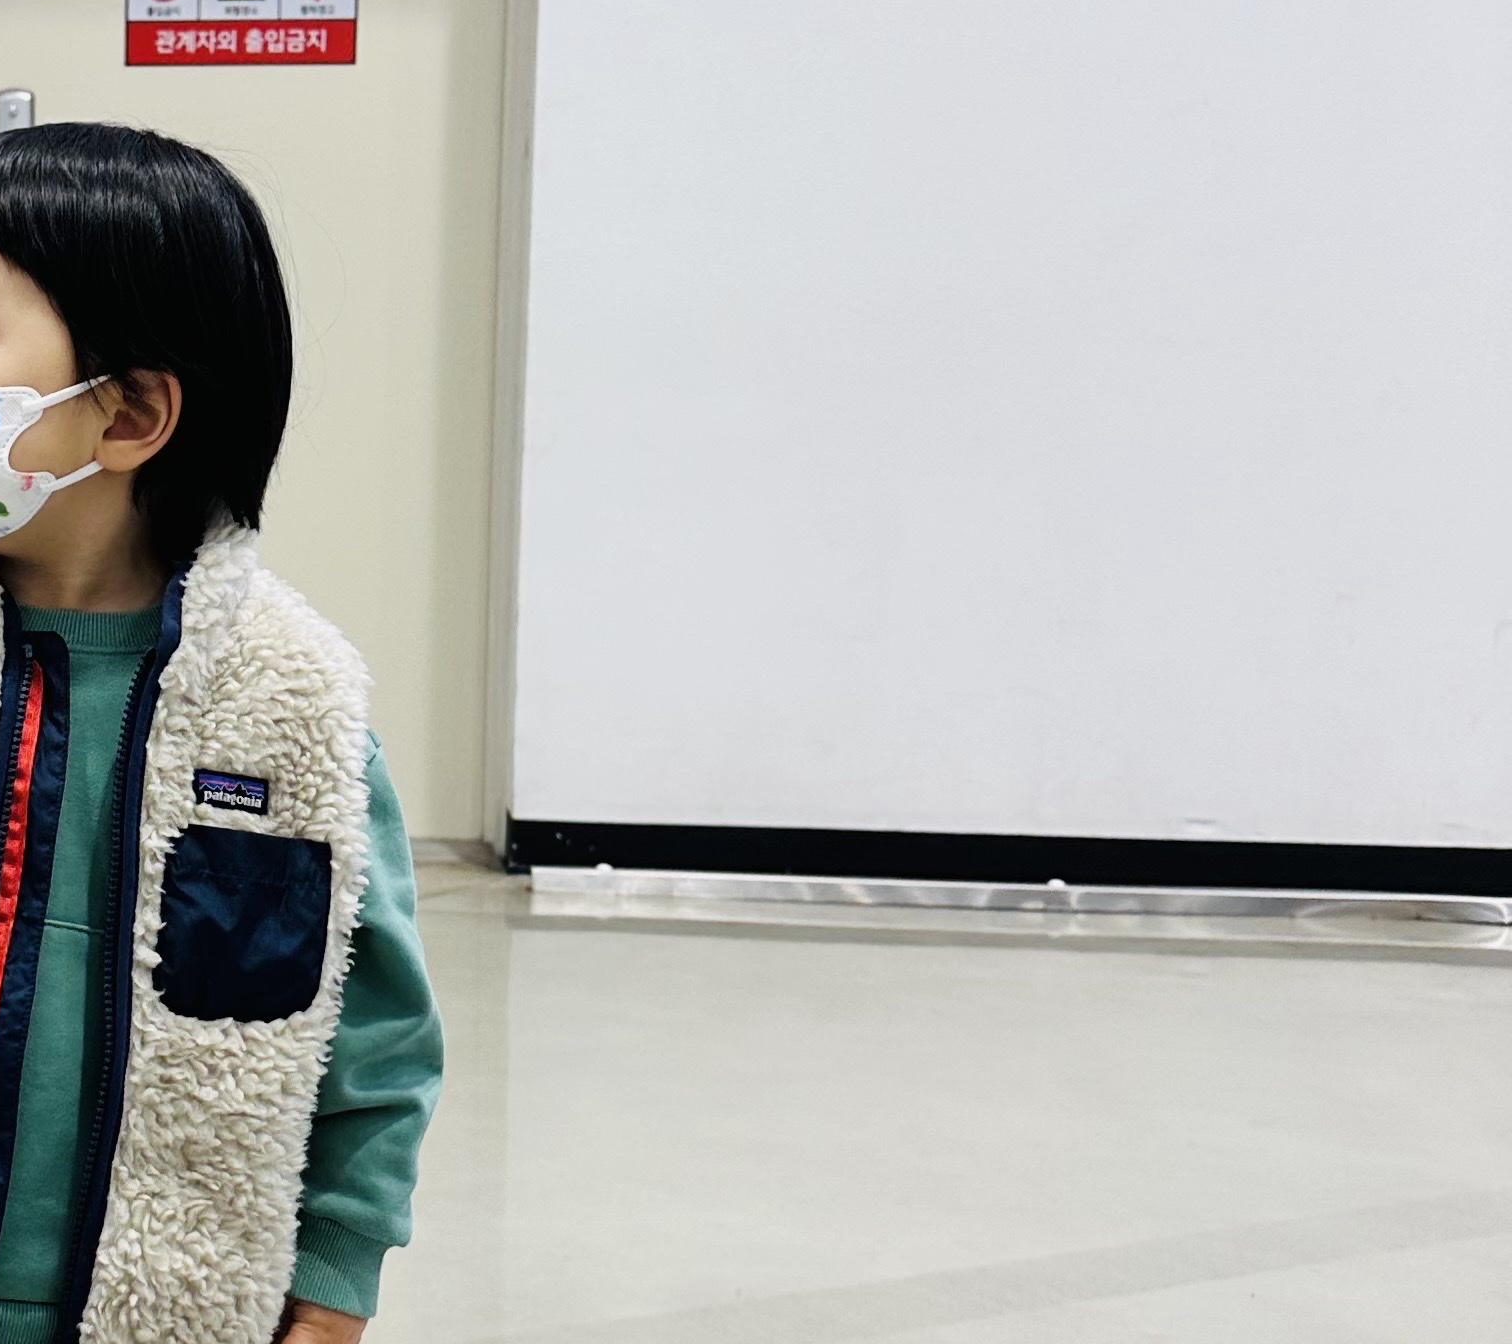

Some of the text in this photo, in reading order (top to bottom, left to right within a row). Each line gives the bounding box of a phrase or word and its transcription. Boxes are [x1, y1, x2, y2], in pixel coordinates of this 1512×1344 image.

[155, 28, 328, 54] 관계자외 출입금지
[203, 790, 263, 808] patagonia
